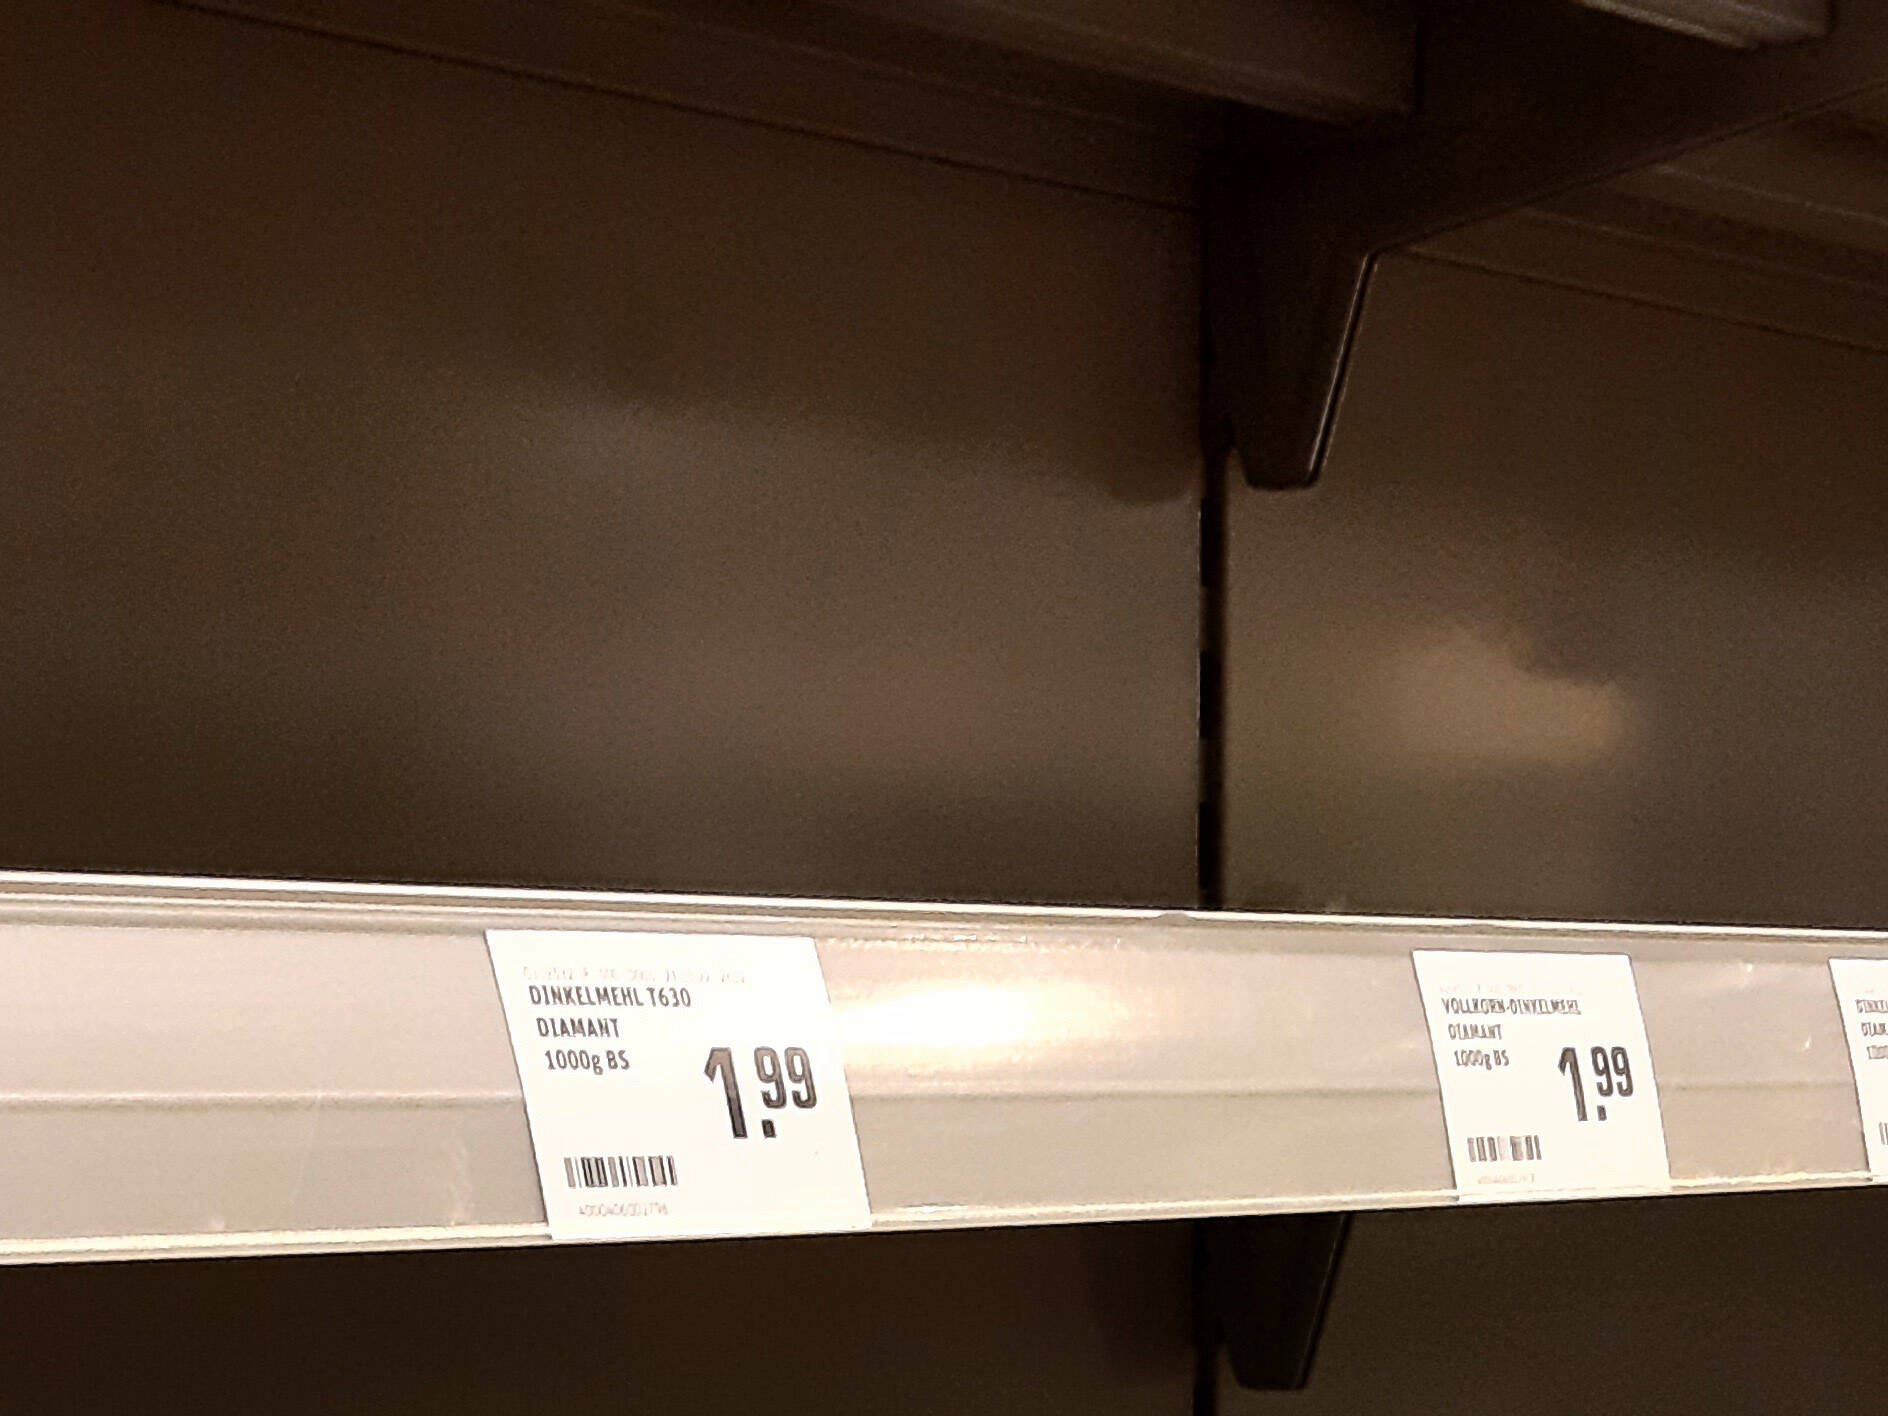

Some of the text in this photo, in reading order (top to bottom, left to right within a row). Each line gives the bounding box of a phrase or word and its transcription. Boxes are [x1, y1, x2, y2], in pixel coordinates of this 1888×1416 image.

[528, 984, 691, 1008] DINKELMEHL T630
[536, 1017, 620, 1038] DIAMANT
[545, 1050, 630, 1075] 1000g BS
[704, 1047, 818, 1139] 1.99
[1558, 1046, 1634, 1122] 1.99
